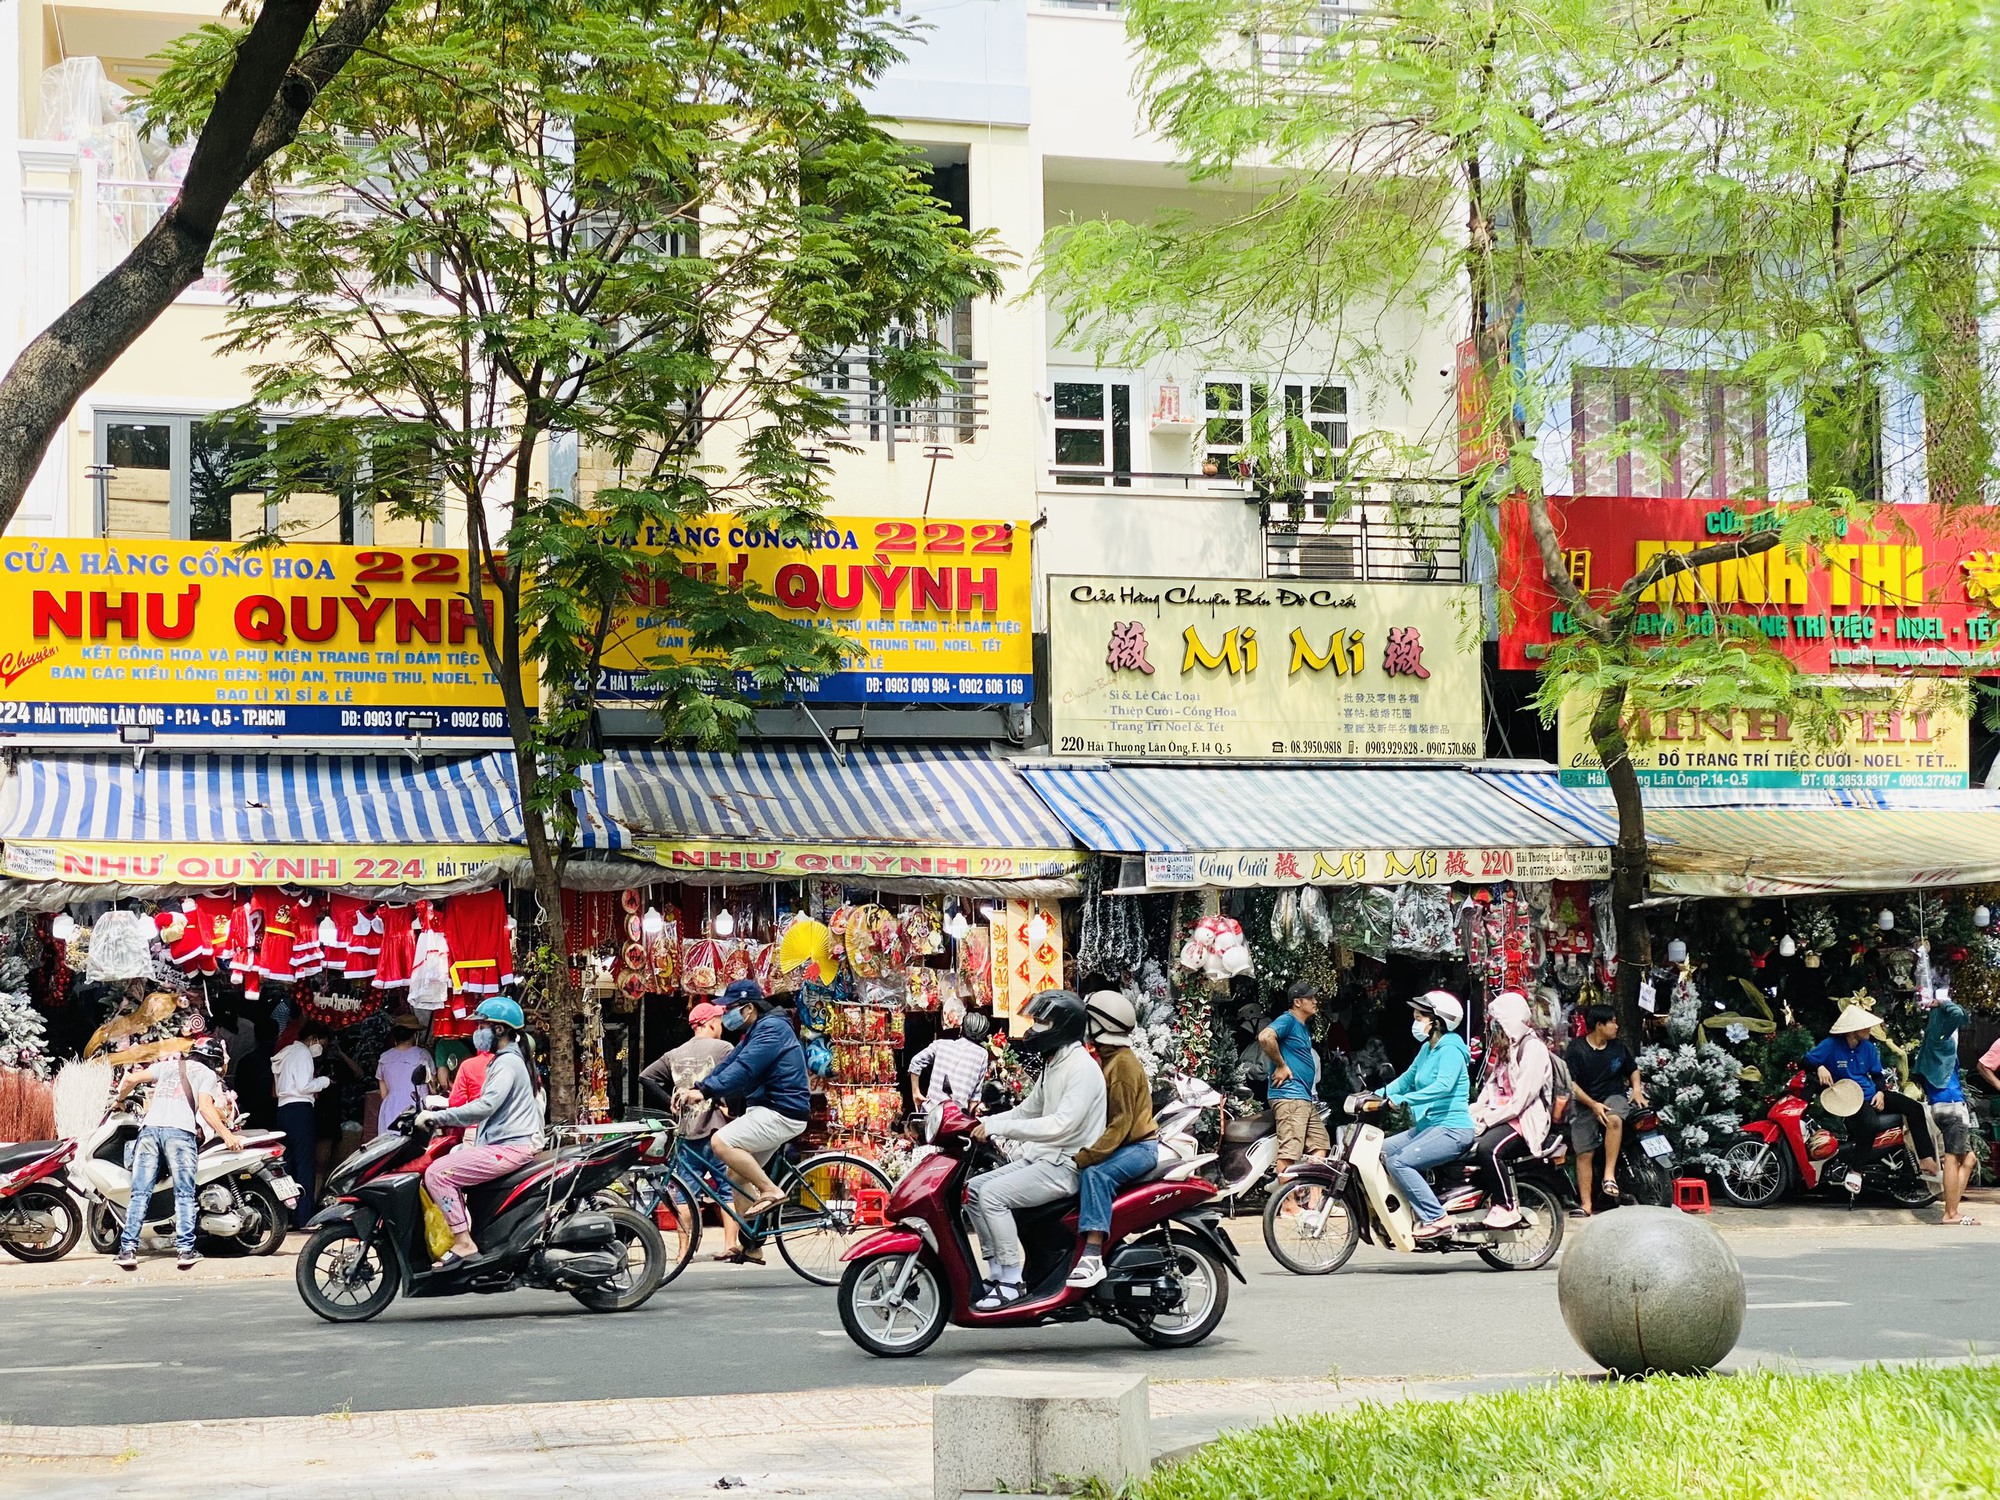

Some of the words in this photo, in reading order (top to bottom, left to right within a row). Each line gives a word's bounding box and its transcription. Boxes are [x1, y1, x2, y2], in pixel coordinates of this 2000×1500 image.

[874, 522, 1013, 554] 222
[4, 542, 70, 575] CỬA
[80, 547, 169, 577] HÀNG
[179, 546, 264, 579] CỔNG
[272, 557, 336, 581] HOA
[774, 553, 998, 613] QUỲNH
[33, 583, 201, 640] NHƯ
[234, 584, 494, 646] QUỲNH
[1070, 585, 1116, 604] Cửa
[1120, 586, 1160, 619] Hàng
[1164, 584, 1231, 619] Chuyên
[1234, 588, 1271, 606] Bán
[1275, 588, 1308, 607] Đồ
[866, 618, 895, 634] KIỆN
[899, 620, 938, 633] TRANG
[964, 619, 991, 633] ĐÁM
[996, 620, 1021, 636] TIỆC
[1832, 611, 1875, 643] TIỆC
[1896, 617, 1946, 640] NOEL
[82, 644, 111, 660] KẾT
[170, 647, 203, 662] HOA
[209, 646, 230, 662] VÀ
[235, 649, 268, 666] PHỤ
[274, 649, 312, 666] KIỆN
[317, 651, 370, 664] TRANG
[375, 650, 400, 664] TRÍ
[405, 650, 441, 665] ĐÁM
[446, 650, 480, 667] TIỆC
[869, 638, 909, 651] TRUNG
[913, 639, 939, 652] THU,
[944, 640, 977, 653] NOEL,
[981, 637, 1002, 652] TẾT
[1105, 620, 1155, 675] 薇
[1181, 623, 1258, 675] Mi
[1288, 626, 1365, 677] Mi
[1382, 626, 1431, 679] 薇
[51, 665, 86, 680] BÁN
[92, 665, 126, 680] CÁC
[131, 664, 169, 681] KIỂU
[225, 667, 263, 682] ĐÈN:
[269, 671, 296, 686] HỘI
[300, 671, 328, 684] AN,
[334, 671, 387, 684] TRUNG
[433, 672, 477, 685] NOEL,
[610, 671, 628, 691] HẢI
[885, 677, 908, 693] 0903
[911, 677, 930, 694] 099
[932, 678, 950, 694] 984
[959, 678, 983, 694] 0902
[985, 679, 1003, 694] 606
[1006, 679, 1024, 695] 169
[216, 689, 248, 701] BAO
[254, 687, 268, 701] LÌ
[318, 690, 329, 702] &
[335, 687, 353, 702] LẺ
[1122, 690, 1132, 700] &
[1151, 690, 1173, 701] Các
[1175, 691, 1201, 703] Loại
[34, 702, 56, 724] HẢI
[59, 705, 108, 728] THƯỢNG
[110, 705, 135, 725] LÃN
[138, 705, 164, 725] ÔNG
[176, 709, 200, 725] P.14
[211, 709, 232, 727] Q.5
[242, 709, 286, 727] TP.HCM
[364, 710, 392, 727] 0903
[452, 711, 479, 728] 0902
[482, 711, 503, 728] 606
[1213, 706, 1237, 717] Hoa
[1109, 721, 1143, 734] Trang
[1166, 721, 1192, 732] Noel
[1194, 722, 1205, 732] &
[1060, 736, 1084, 752] 220
[1290, 741, 1342, 754] 08.3950.9818
[1365, 741, 1418, 755] 0903.929.828
[1426, 742, 1476, 756] 0907.570.868
[1658, 747, 1680, 767] ĐỒ
[1686, 753, 1739, 767] TRANG
[1745, 750, 1769, 767] TRÍ
[1774, 750, 1810, 772] TIỆC
[1864, 754, 1903, 768] NOEL
[1588, 771, 1606, 785] Hải
[1654, 772, 1673, 786] Lãn
[1677, 770, 1700, 788] Ông
[1801, 773, 1820, 787] ĐT:
[1823, 774, 1890, 787] 08.3853.8317
[1899, 775, 1963, 788] 0903.377847
[63, 853, 168, 877] NHƯ
[177, 851, 341, 879] QUỲNH
[354, 858, 425, 879] 224
[437, 856, 456, 877] HẢI
[672, 849, 784, 870] NHƯ
[795, 850, 968, 875] QUỲNH
[981, 857, 1013, 876] 222
[1019, 857, 1032, 875] HẢI
[1311, 851, 1366, 879] Mi
[1384, 850, 1437, 879] Mi
[1481, 850, 1514, 876] 220
